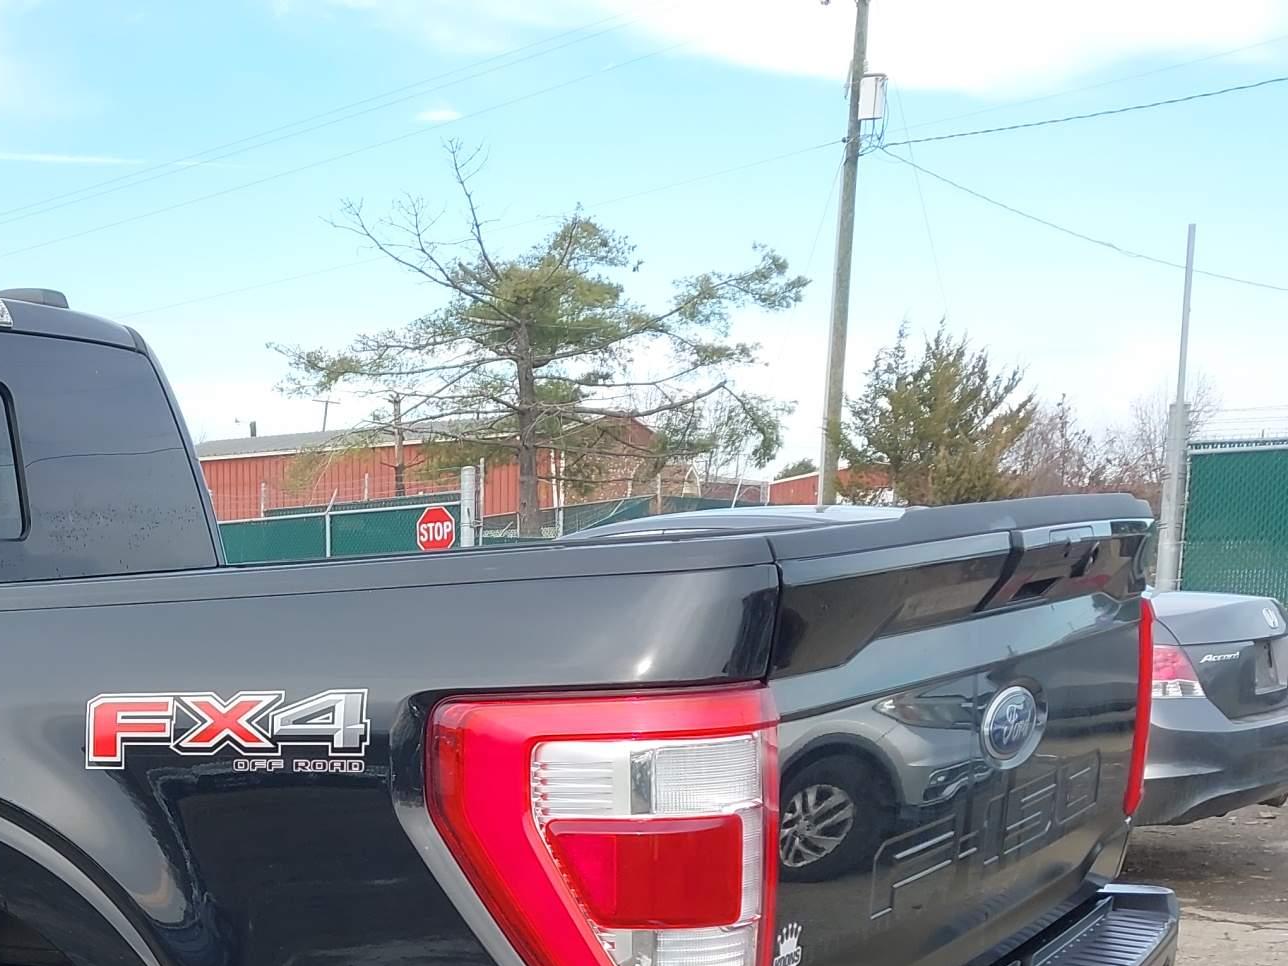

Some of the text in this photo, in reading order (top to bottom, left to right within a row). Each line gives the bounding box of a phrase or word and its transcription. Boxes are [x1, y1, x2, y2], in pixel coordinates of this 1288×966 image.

[420, 521, 452, 542] STOP
[85, 689, 370, 769] FX4
[233, 759, 365, 772] OFF ROAD
